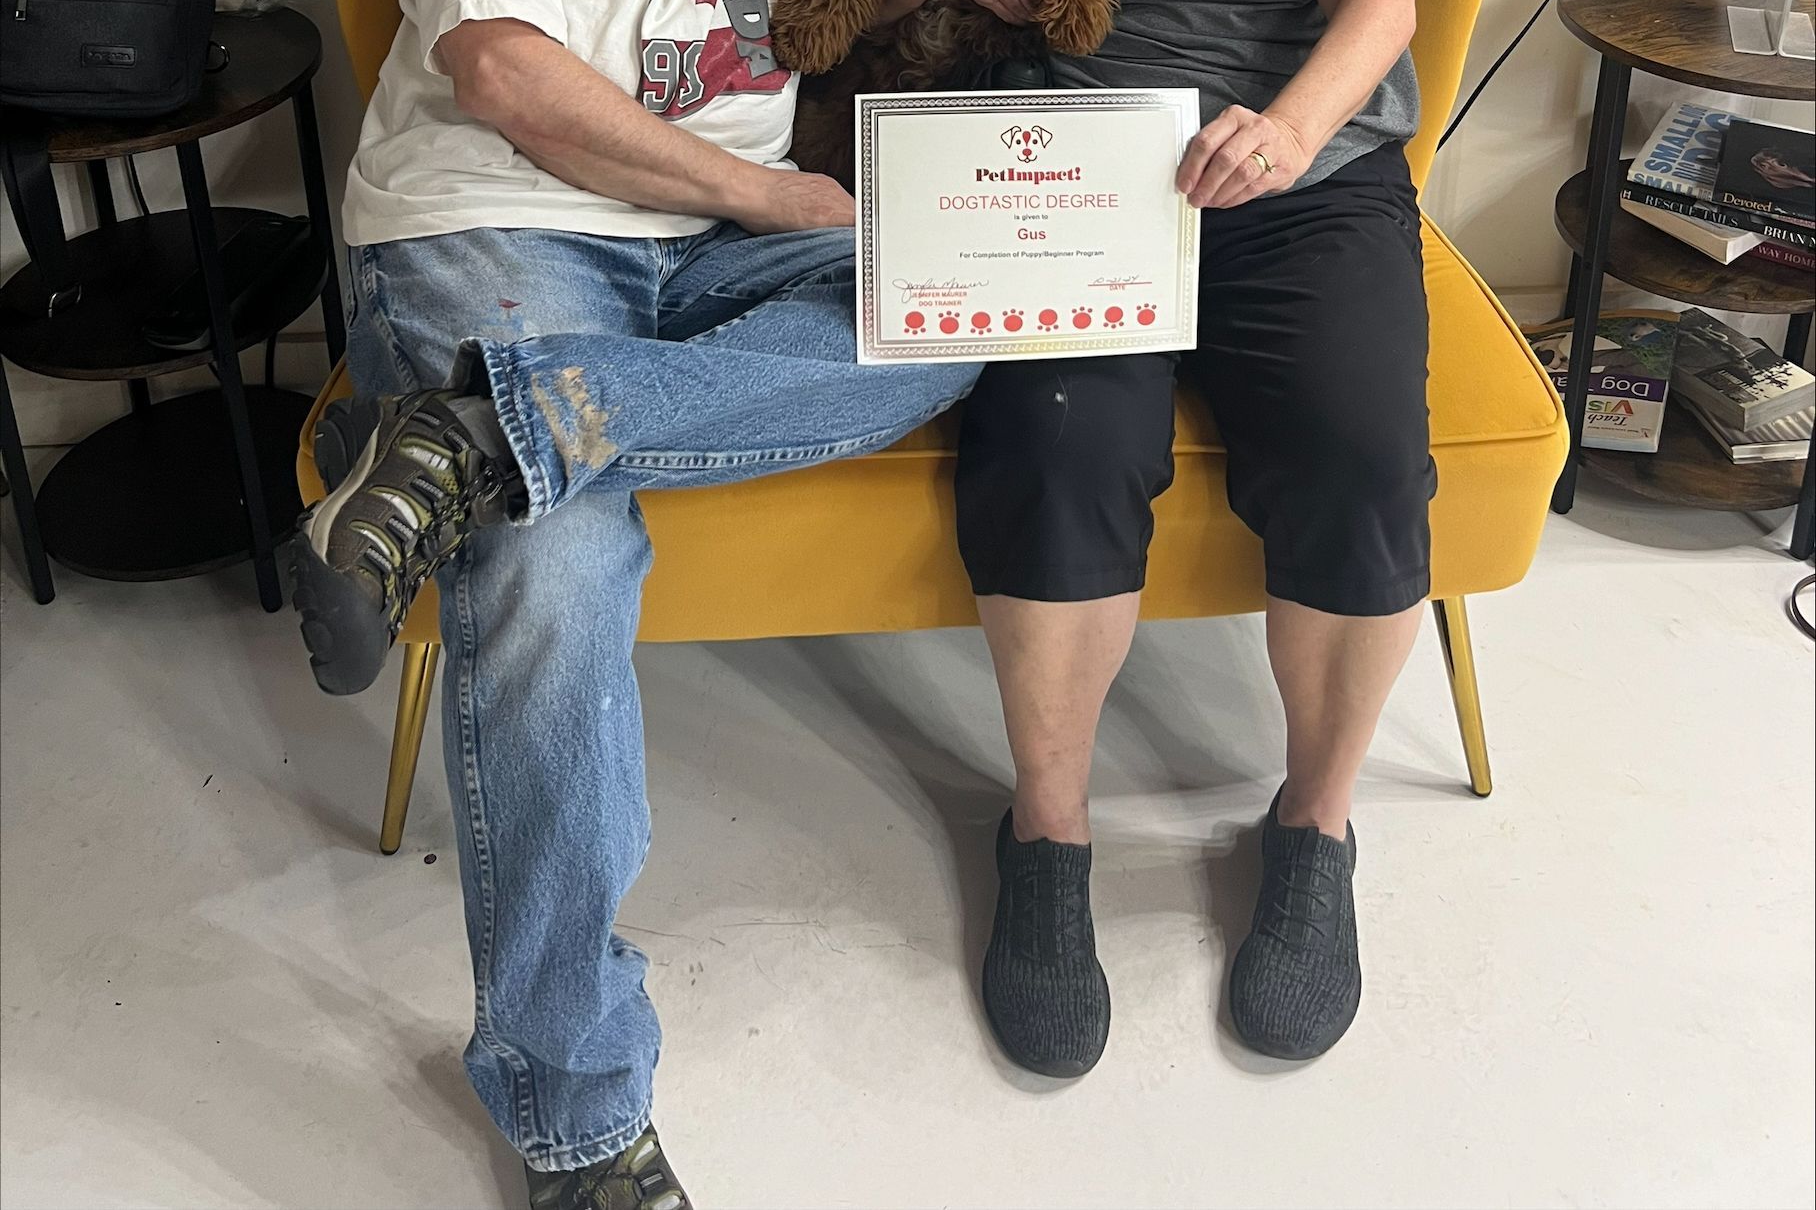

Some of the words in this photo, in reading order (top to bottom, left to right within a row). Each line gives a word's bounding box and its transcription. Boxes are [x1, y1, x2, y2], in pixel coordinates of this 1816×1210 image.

[976, 167, 1081, 185] PetImpact!
[939, 194, 1041, 210] DOGTASTIC
[1046, 194, 1119, 208] DEGREE
[1723, 192, 1772, 212] Devoted
[1022, 213, 1041, 221] given
[1645, 194, 1697, 216] RESCUE
[1703, 208, 1739, 227] TAILS
[1017, 228, 1046, 240] Gus
[1764, 225, 1806, 245] BRIAN
[972, 251, 1011, 259] Completion
[1021, 250, 1074, 259] Puppy/Beginner
[1075, 250, 1105, 258] Program
[1758, 245, 1781, 259] WAY
[1601, 376, 1650, 397] Dog
[1587, 413, 1628, 427] Teach
